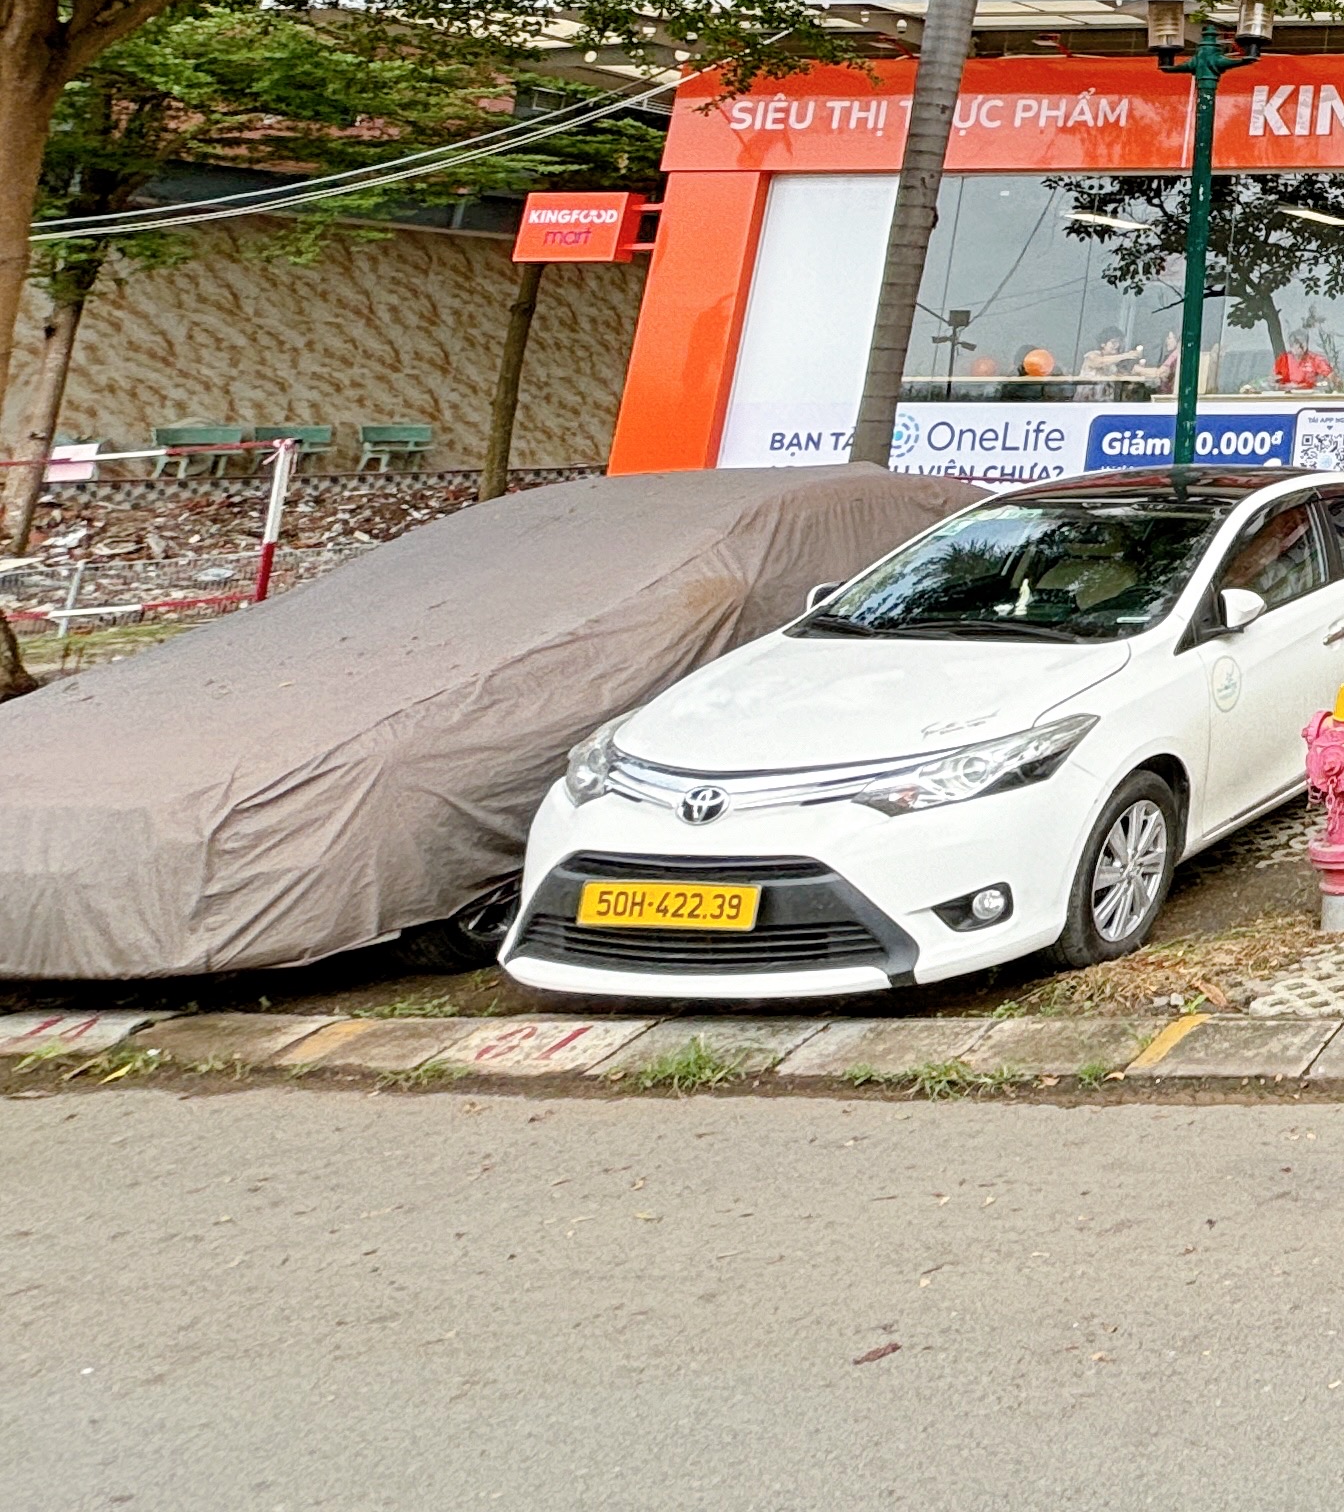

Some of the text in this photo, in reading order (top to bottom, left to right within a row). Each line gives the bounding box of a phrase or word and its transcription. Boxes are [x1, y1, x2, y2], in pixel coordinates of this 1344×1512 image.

[729, 87, 1130, 136] SIÊU THỊ TỰC PHẨM
[528, 209, 618, 224] KINGFOOD
[543, 228, 592, 246] mart
[769, 432, 823, 457] BẠN
[927, 420, 1065, 452] OneLife
[1101, 430, 1284, 456] Giảm 0.000đ
